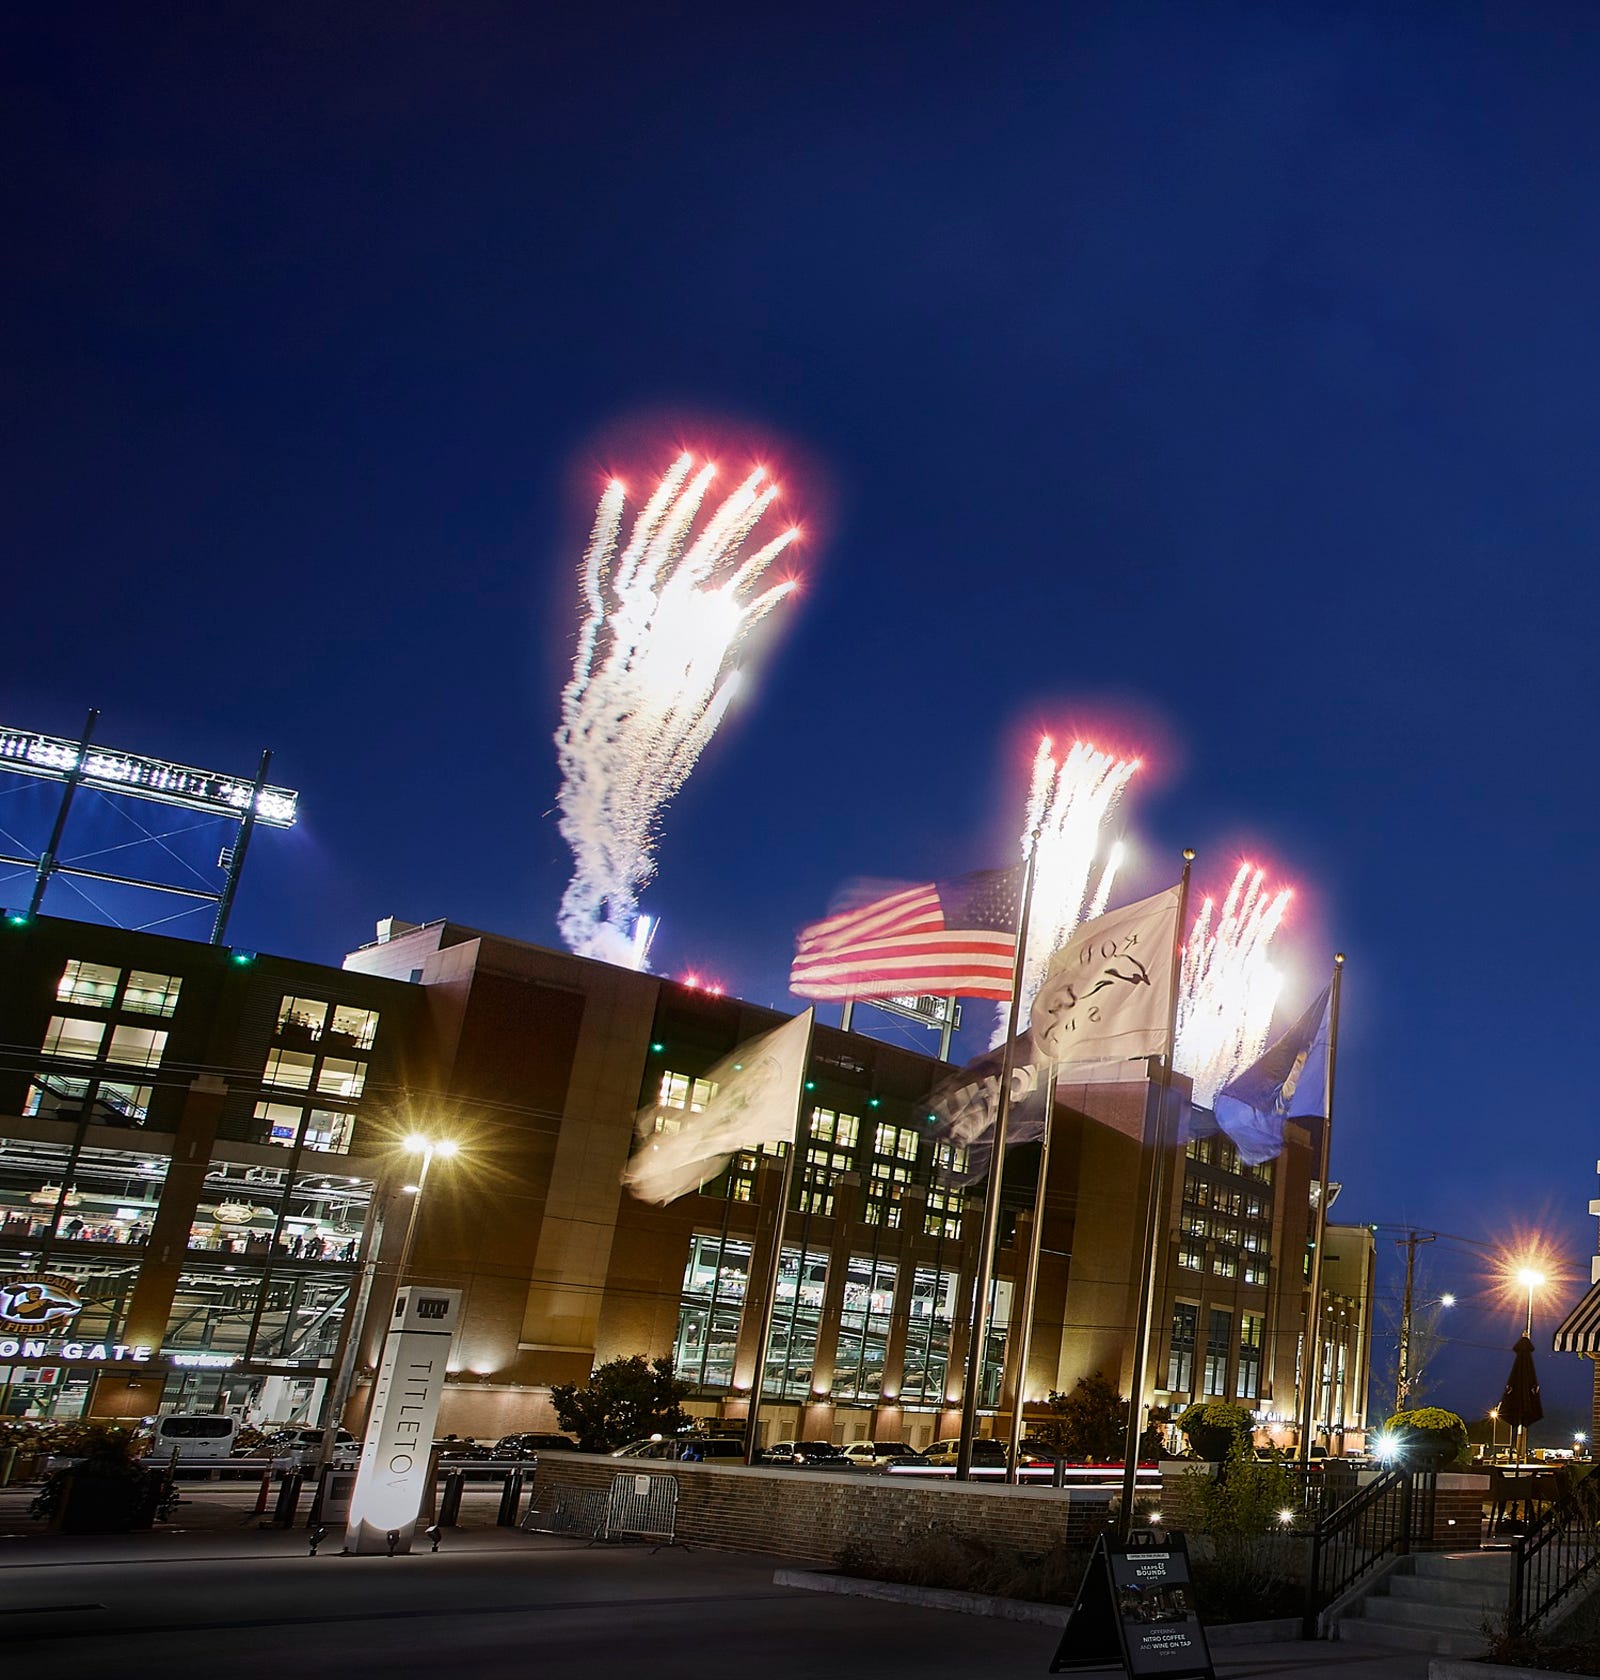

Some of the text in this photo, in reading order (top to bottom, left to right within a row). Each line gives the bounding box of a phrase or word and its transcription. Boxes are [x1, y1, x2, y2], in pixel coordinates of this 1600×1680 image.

[6, 1273, 70, 1289] LAMBEAU
[5, 1323, 46, 1333] FIELD
[62, 1343, 151, 1362] GATE
[1162, 1634, 1186, 1642] COFFEE
